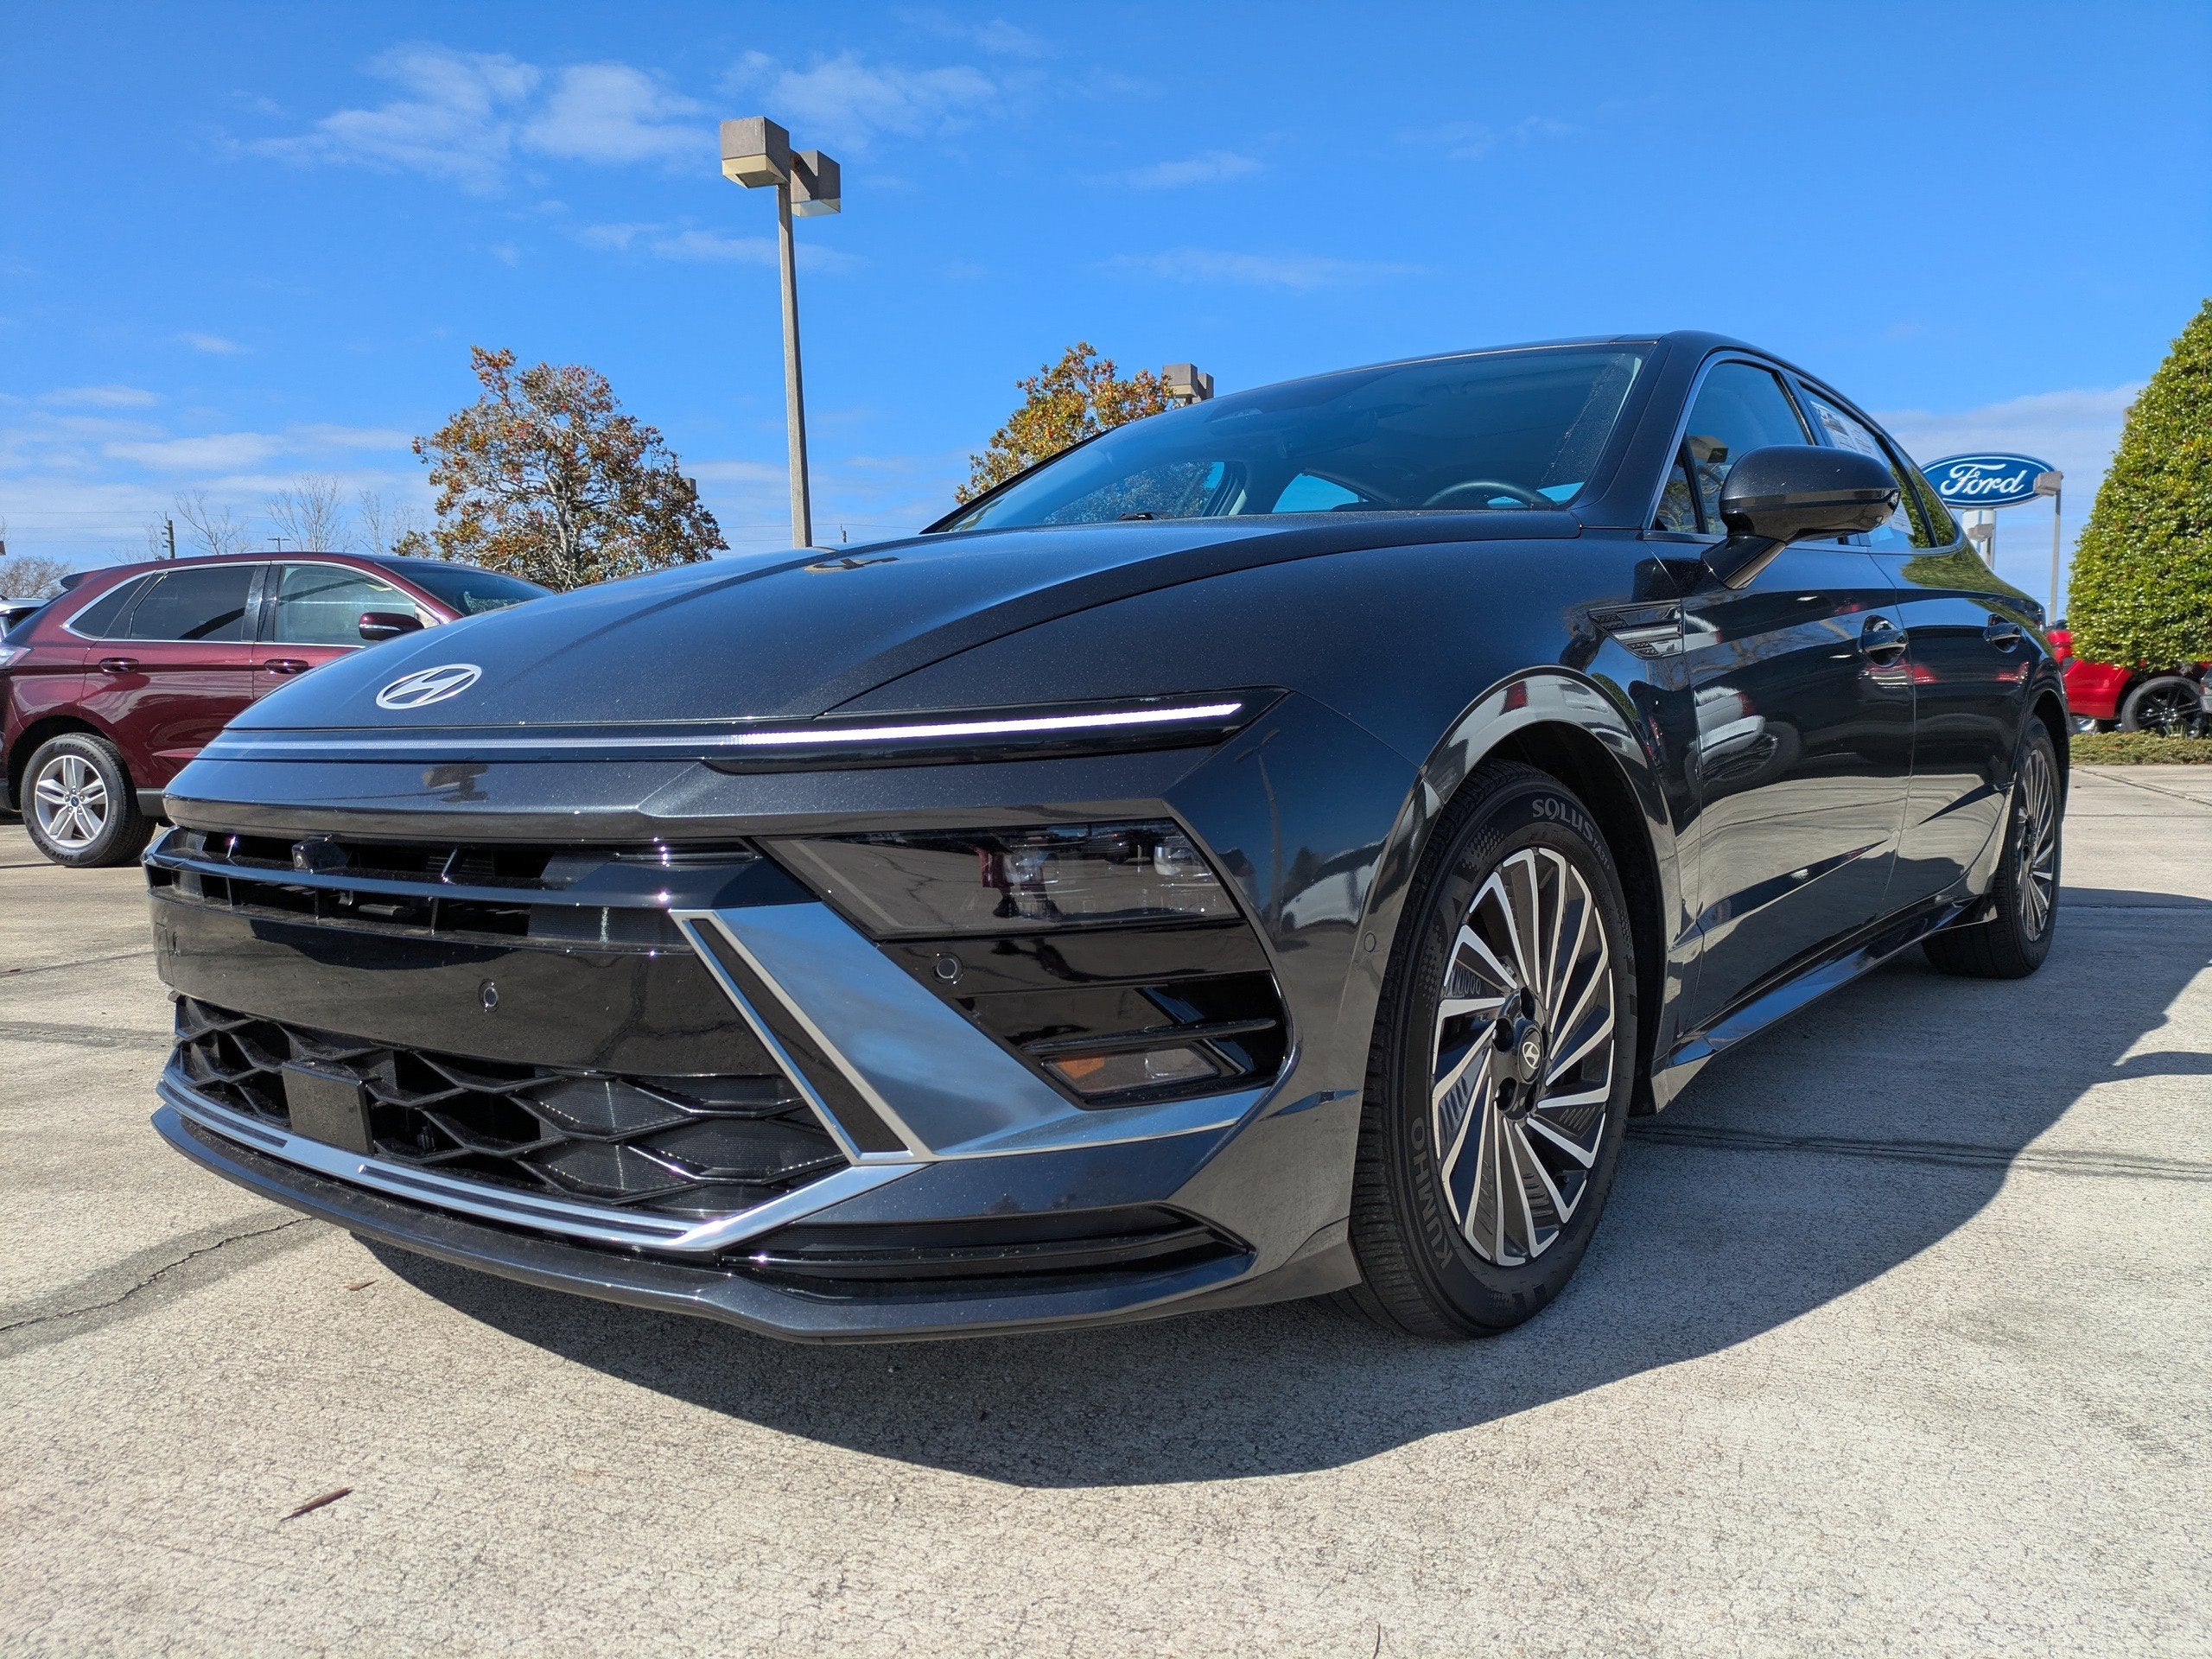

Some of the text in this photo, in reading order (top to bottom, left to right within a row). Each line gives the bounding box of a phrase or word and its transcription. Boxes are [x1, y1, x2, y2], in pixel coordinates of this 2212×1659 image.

[1940, 463, 2028, 496] Ford
[59, 743, 103, 766] TOURING
[1532, 798, 1593, 842] SOLUS
[1411, 1117, 1454, 1269] KUMHO
